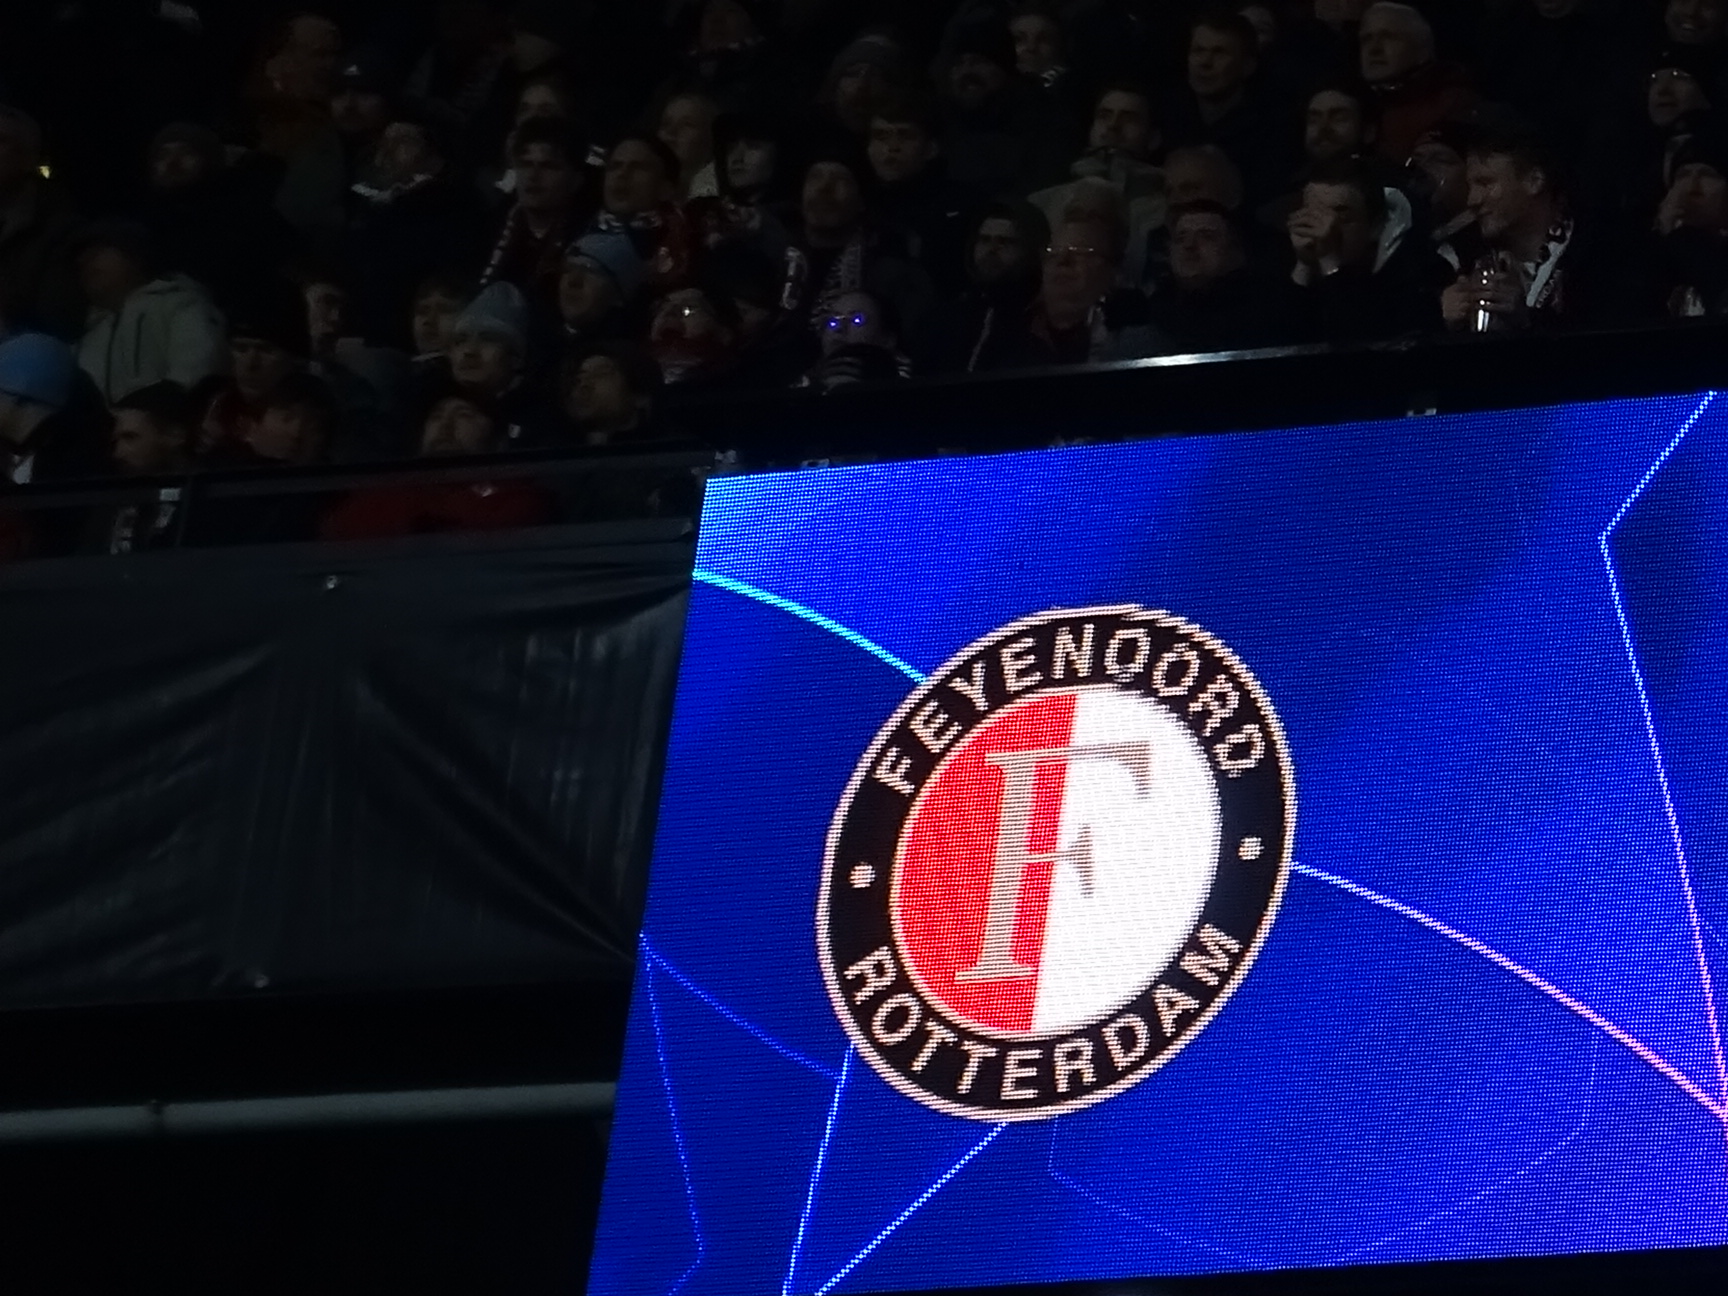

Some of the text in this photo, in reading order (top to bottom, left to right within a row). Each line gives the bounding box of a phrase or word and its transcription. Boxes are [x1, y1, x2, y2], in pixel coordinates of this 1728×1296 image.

[874, 623, 1266, 796] FEYENOORD
[955, 741, 1151, 984] F
[844, 922, 1241, 1100] ROTTERDAM
